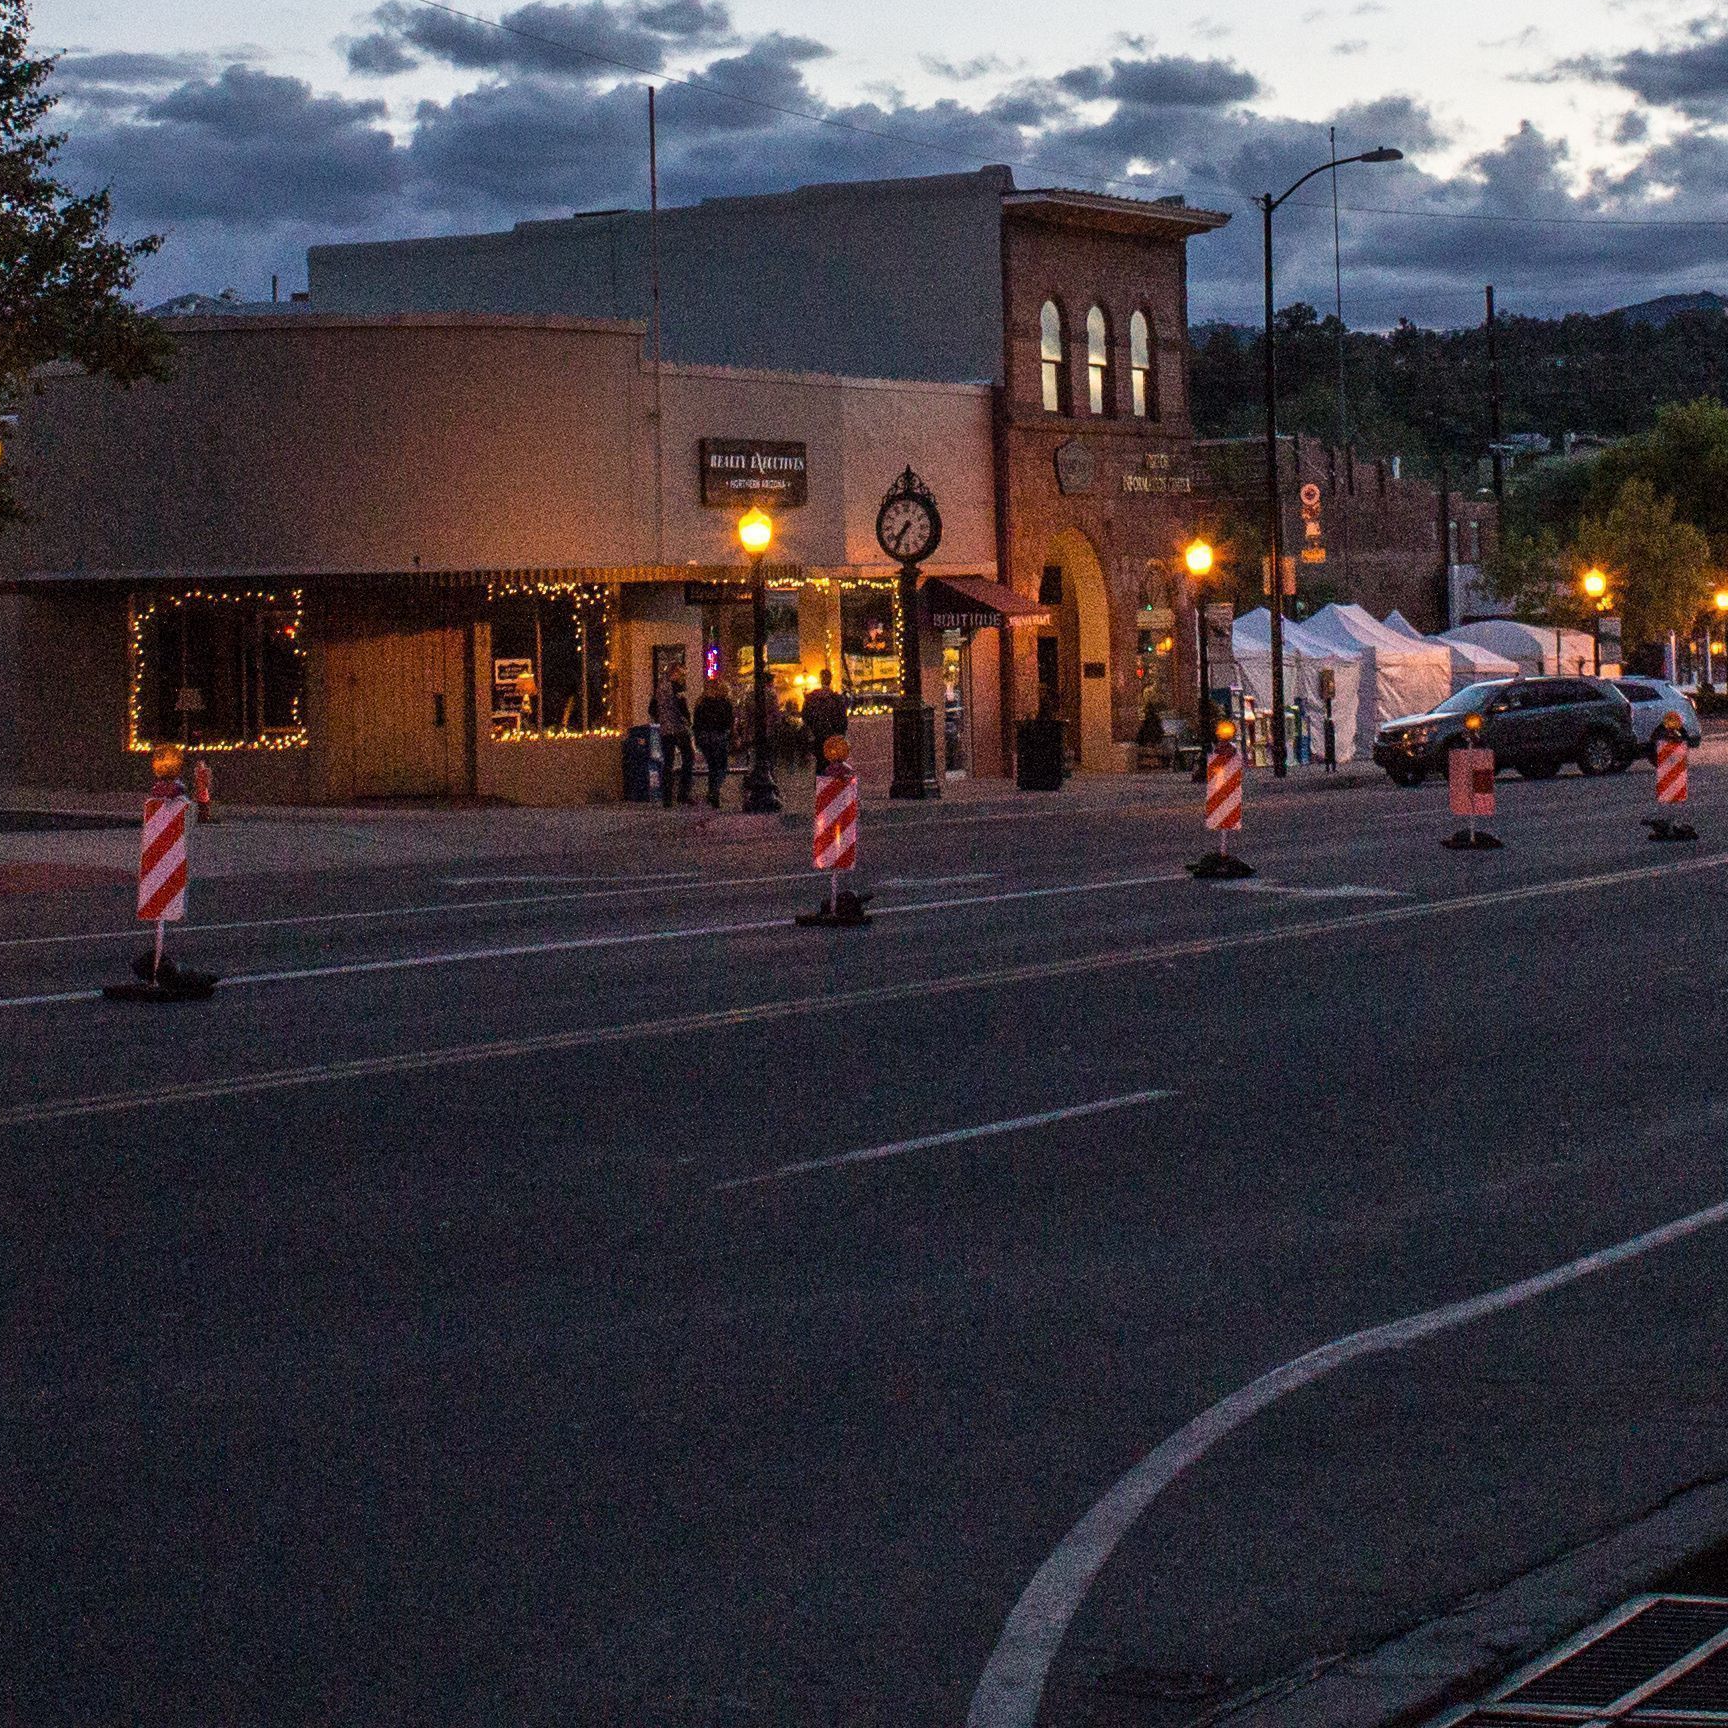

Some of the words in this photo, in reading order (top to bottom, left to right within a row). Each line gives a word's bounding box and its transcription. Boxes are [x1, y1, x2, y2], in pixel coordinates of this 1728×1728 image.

[710, 454, 746, 469] REALTY
[751, 452, 805, 474] EXECUTIVES
[933, 611, 1002, 627] BOUTIQUE
